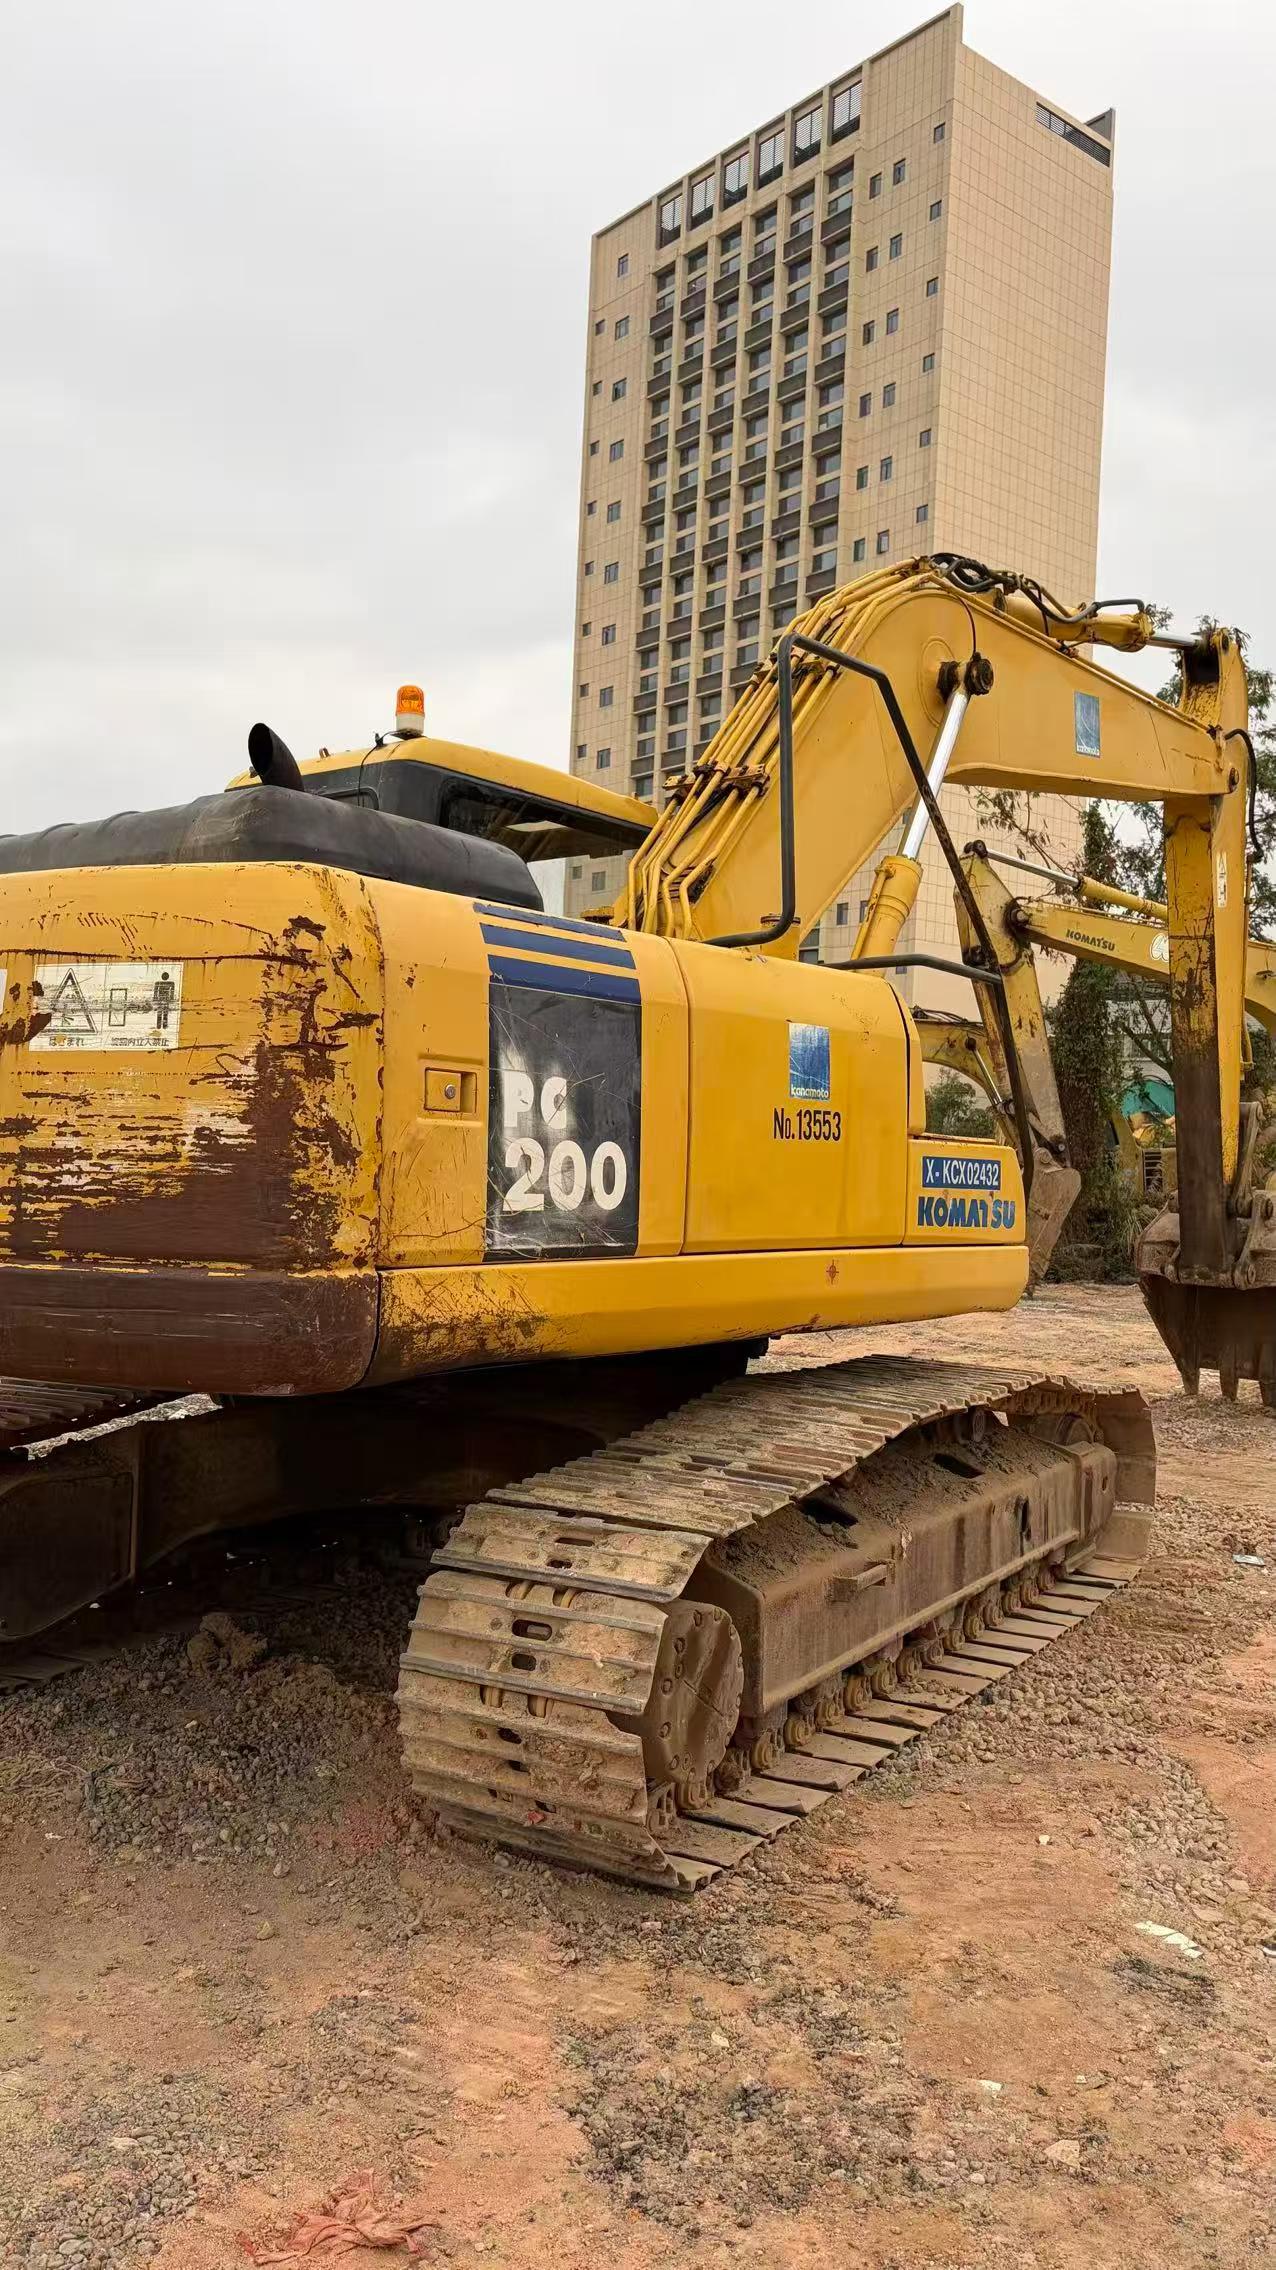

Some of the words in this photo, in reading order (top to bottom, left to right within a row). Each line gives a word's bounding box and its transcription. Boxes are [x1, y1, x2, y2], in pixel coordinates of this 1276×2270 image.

[1066, 929, 1115, 952] KOMATSU
[49, 1037, 85, 1047] はまれ
[503, 1071, 567, 1129] PC
[773, 1107, 841, 1142] No.13553
[502, 1137, 627, 1212] 200
[917, 1196, 1016, 1229] KOMATSU
